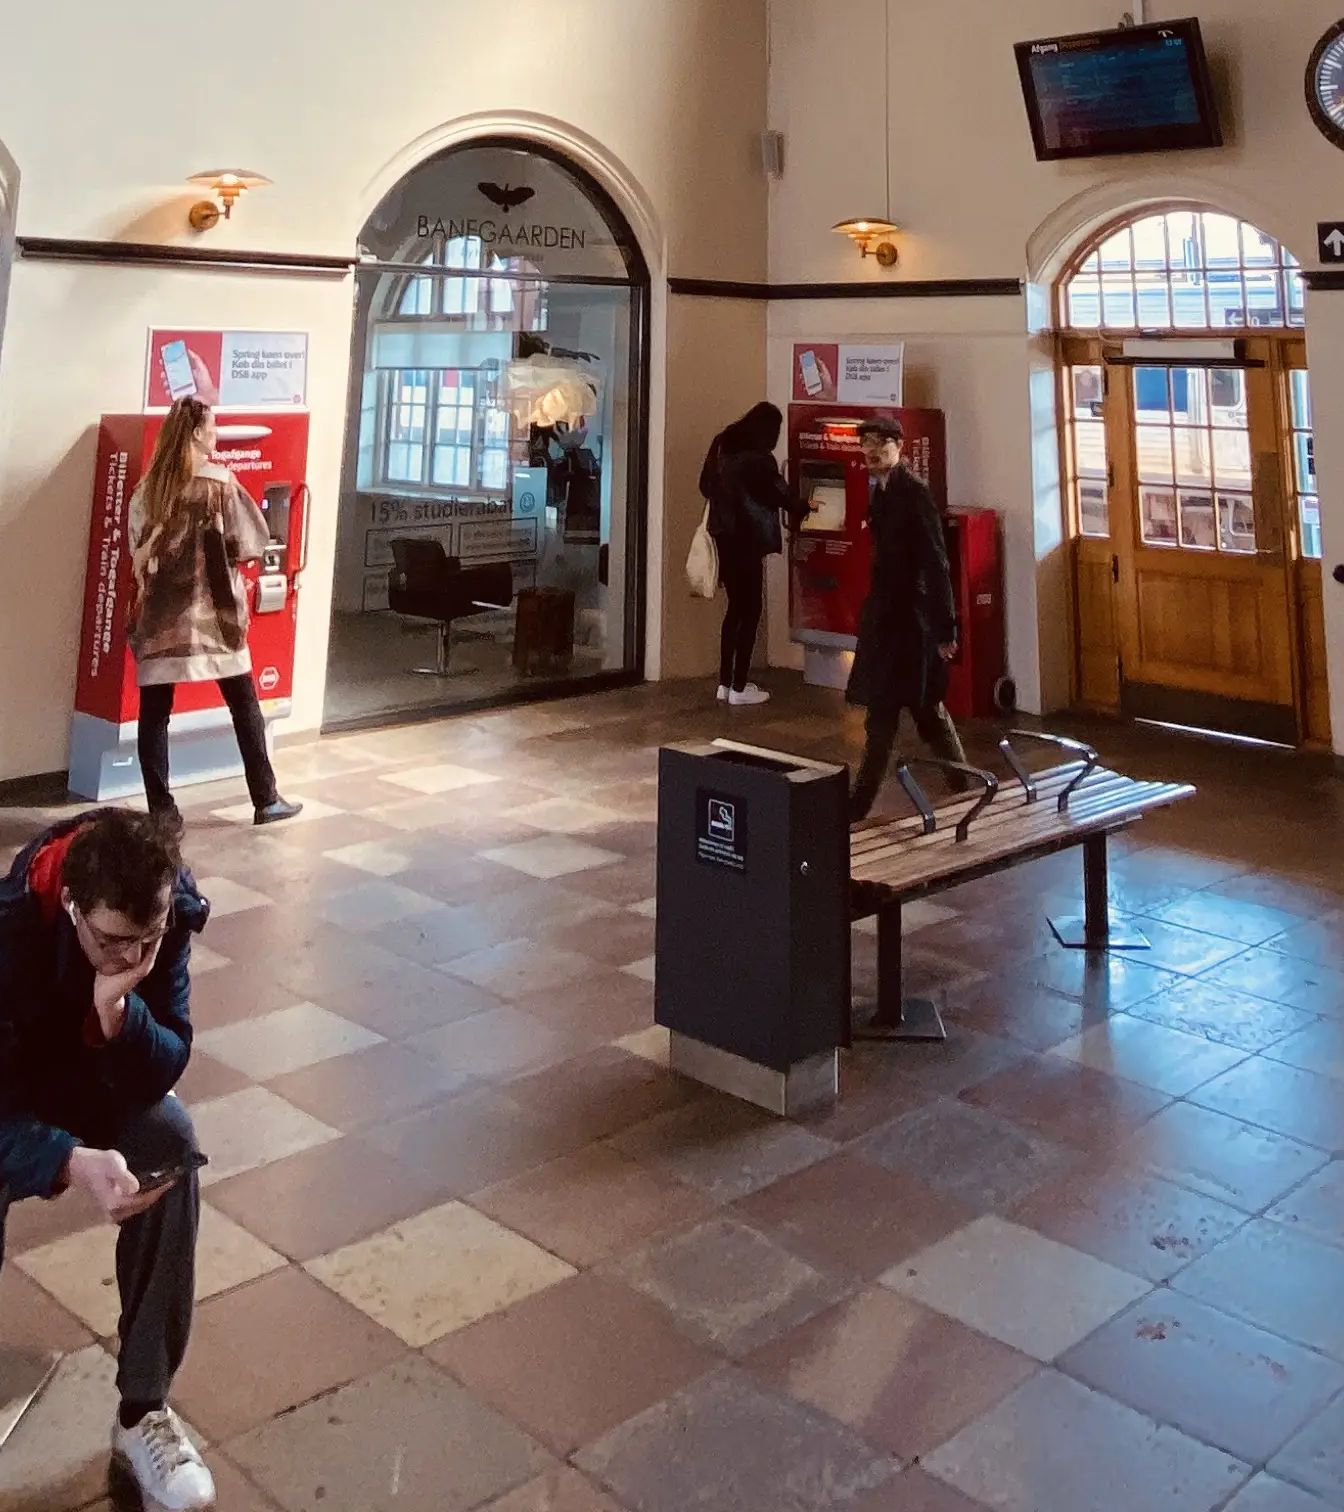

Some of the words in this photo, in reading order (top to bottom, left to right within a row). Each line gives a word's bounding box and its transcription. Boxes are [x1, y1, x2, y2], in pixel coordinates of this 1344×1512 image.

[417, 215, 587, 249] BANEGAARDEN
[251, 372, 268, 381] app
[105, 452, 118, 511] Tickets
[114, 452, 128, 524] Billetter
[104, 516, 112, 528] &
[371, 499, 408, 522] 15%
[414, 493, 514, 520] studierabat
[113, 528, 121, 542] &
[101, 536, 111, 577] Train
[103, 547, 119, 653] Togafgange
[91, 582, 107, 677] departures
